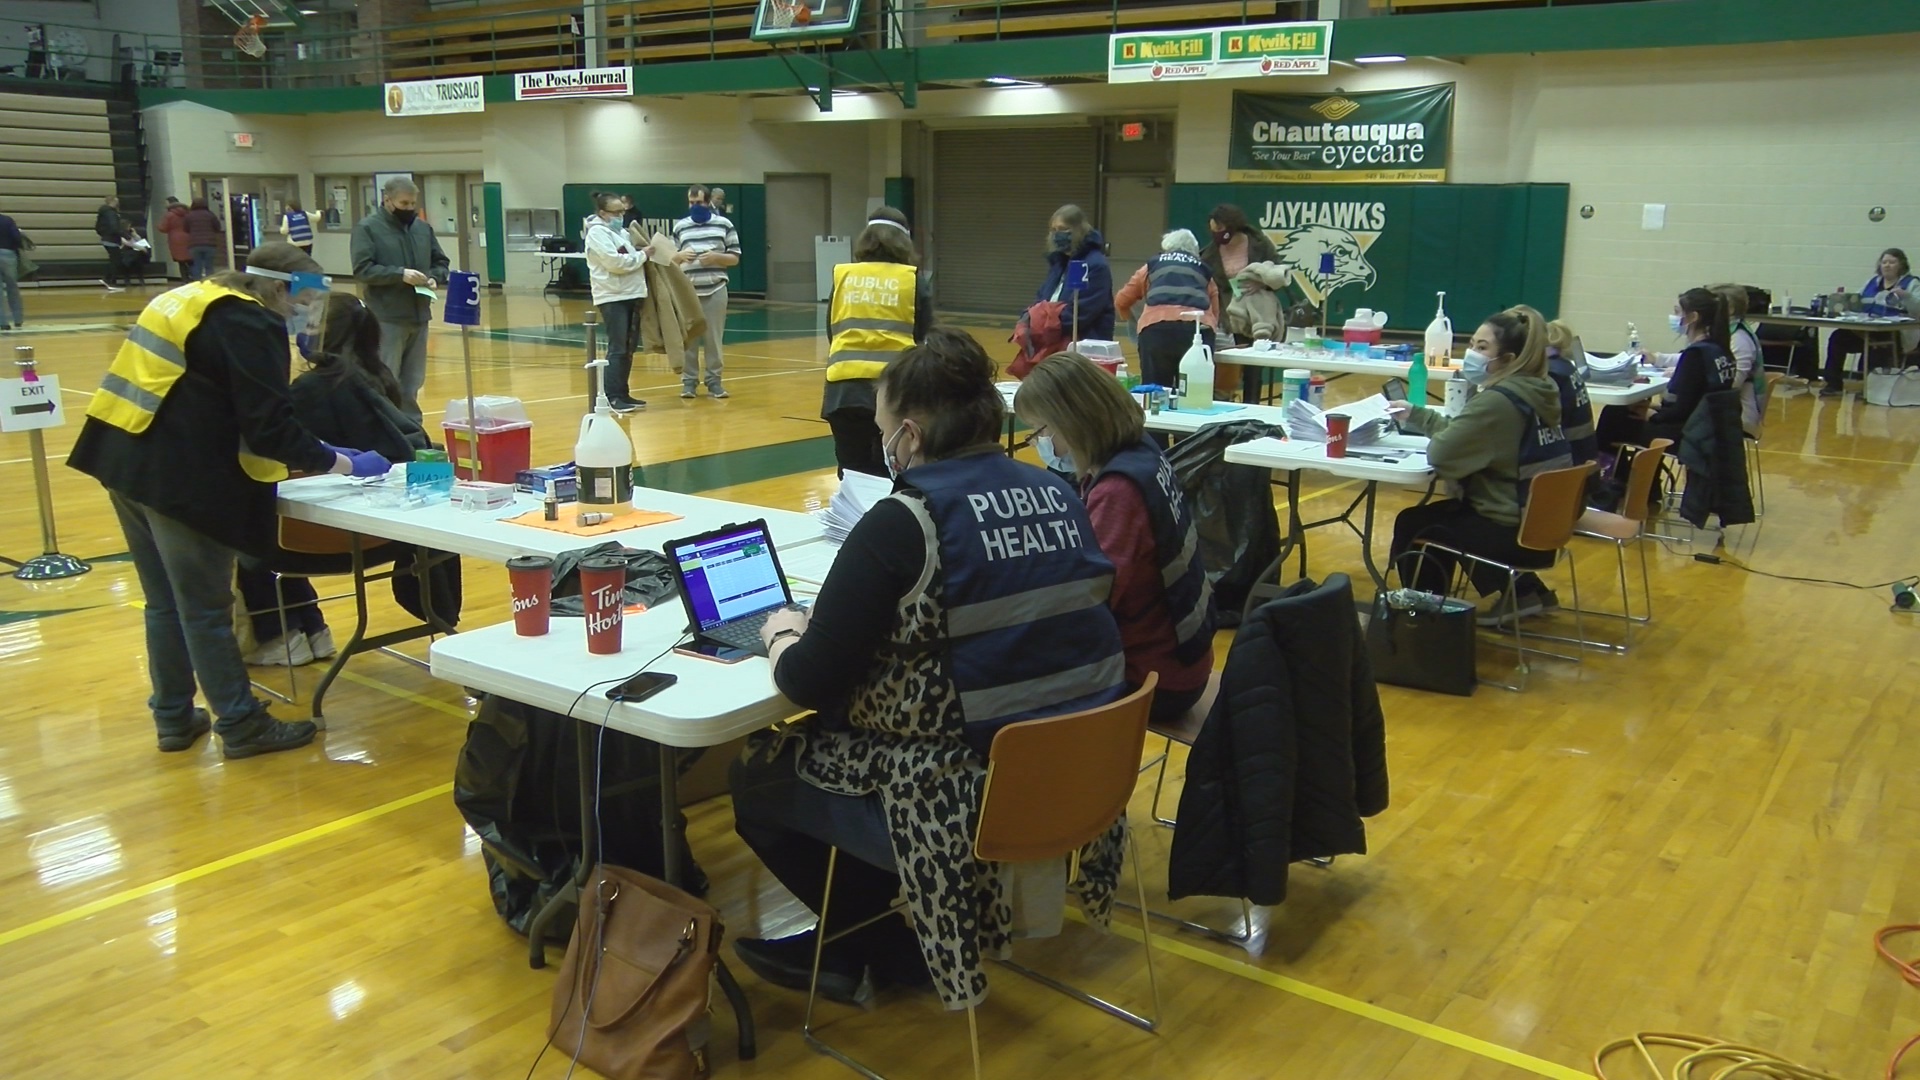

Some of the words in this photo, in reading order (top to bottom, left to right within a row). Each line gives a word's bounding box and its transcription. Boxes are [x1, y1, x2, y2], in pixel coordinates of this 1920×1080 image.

[1165, 66, 1181, 74] RED
[1182, 65, 1205, 74] APPLE
[1273, 61, 1291, 69] RED
[1292, 60, 1318, 69] APPLE
[520, 75, 543, 88] The
[545, 69, 627, 87] Post-Journal
[436, 81, 480, 100] TRUSSALO
[1252, 121, 1425, 145] Chautauqua
[1271, 151, 1291, 161] Your
[1321, 143, 1425, 169] eyecare
[1259, 202, 1386, 229] JAYHAWKS
[1081, 262, 1089, 282] 2
[466, 276, 480, 306] 3
[844, 275, 899, 290] PUBLIC
[843, 291, 899, 306] HEALTH
[21, 385, 45, 396] EXIT
[967, 485, 1068, 523] PUBLIC
[980, 519, 1083, 561] HEALTH
